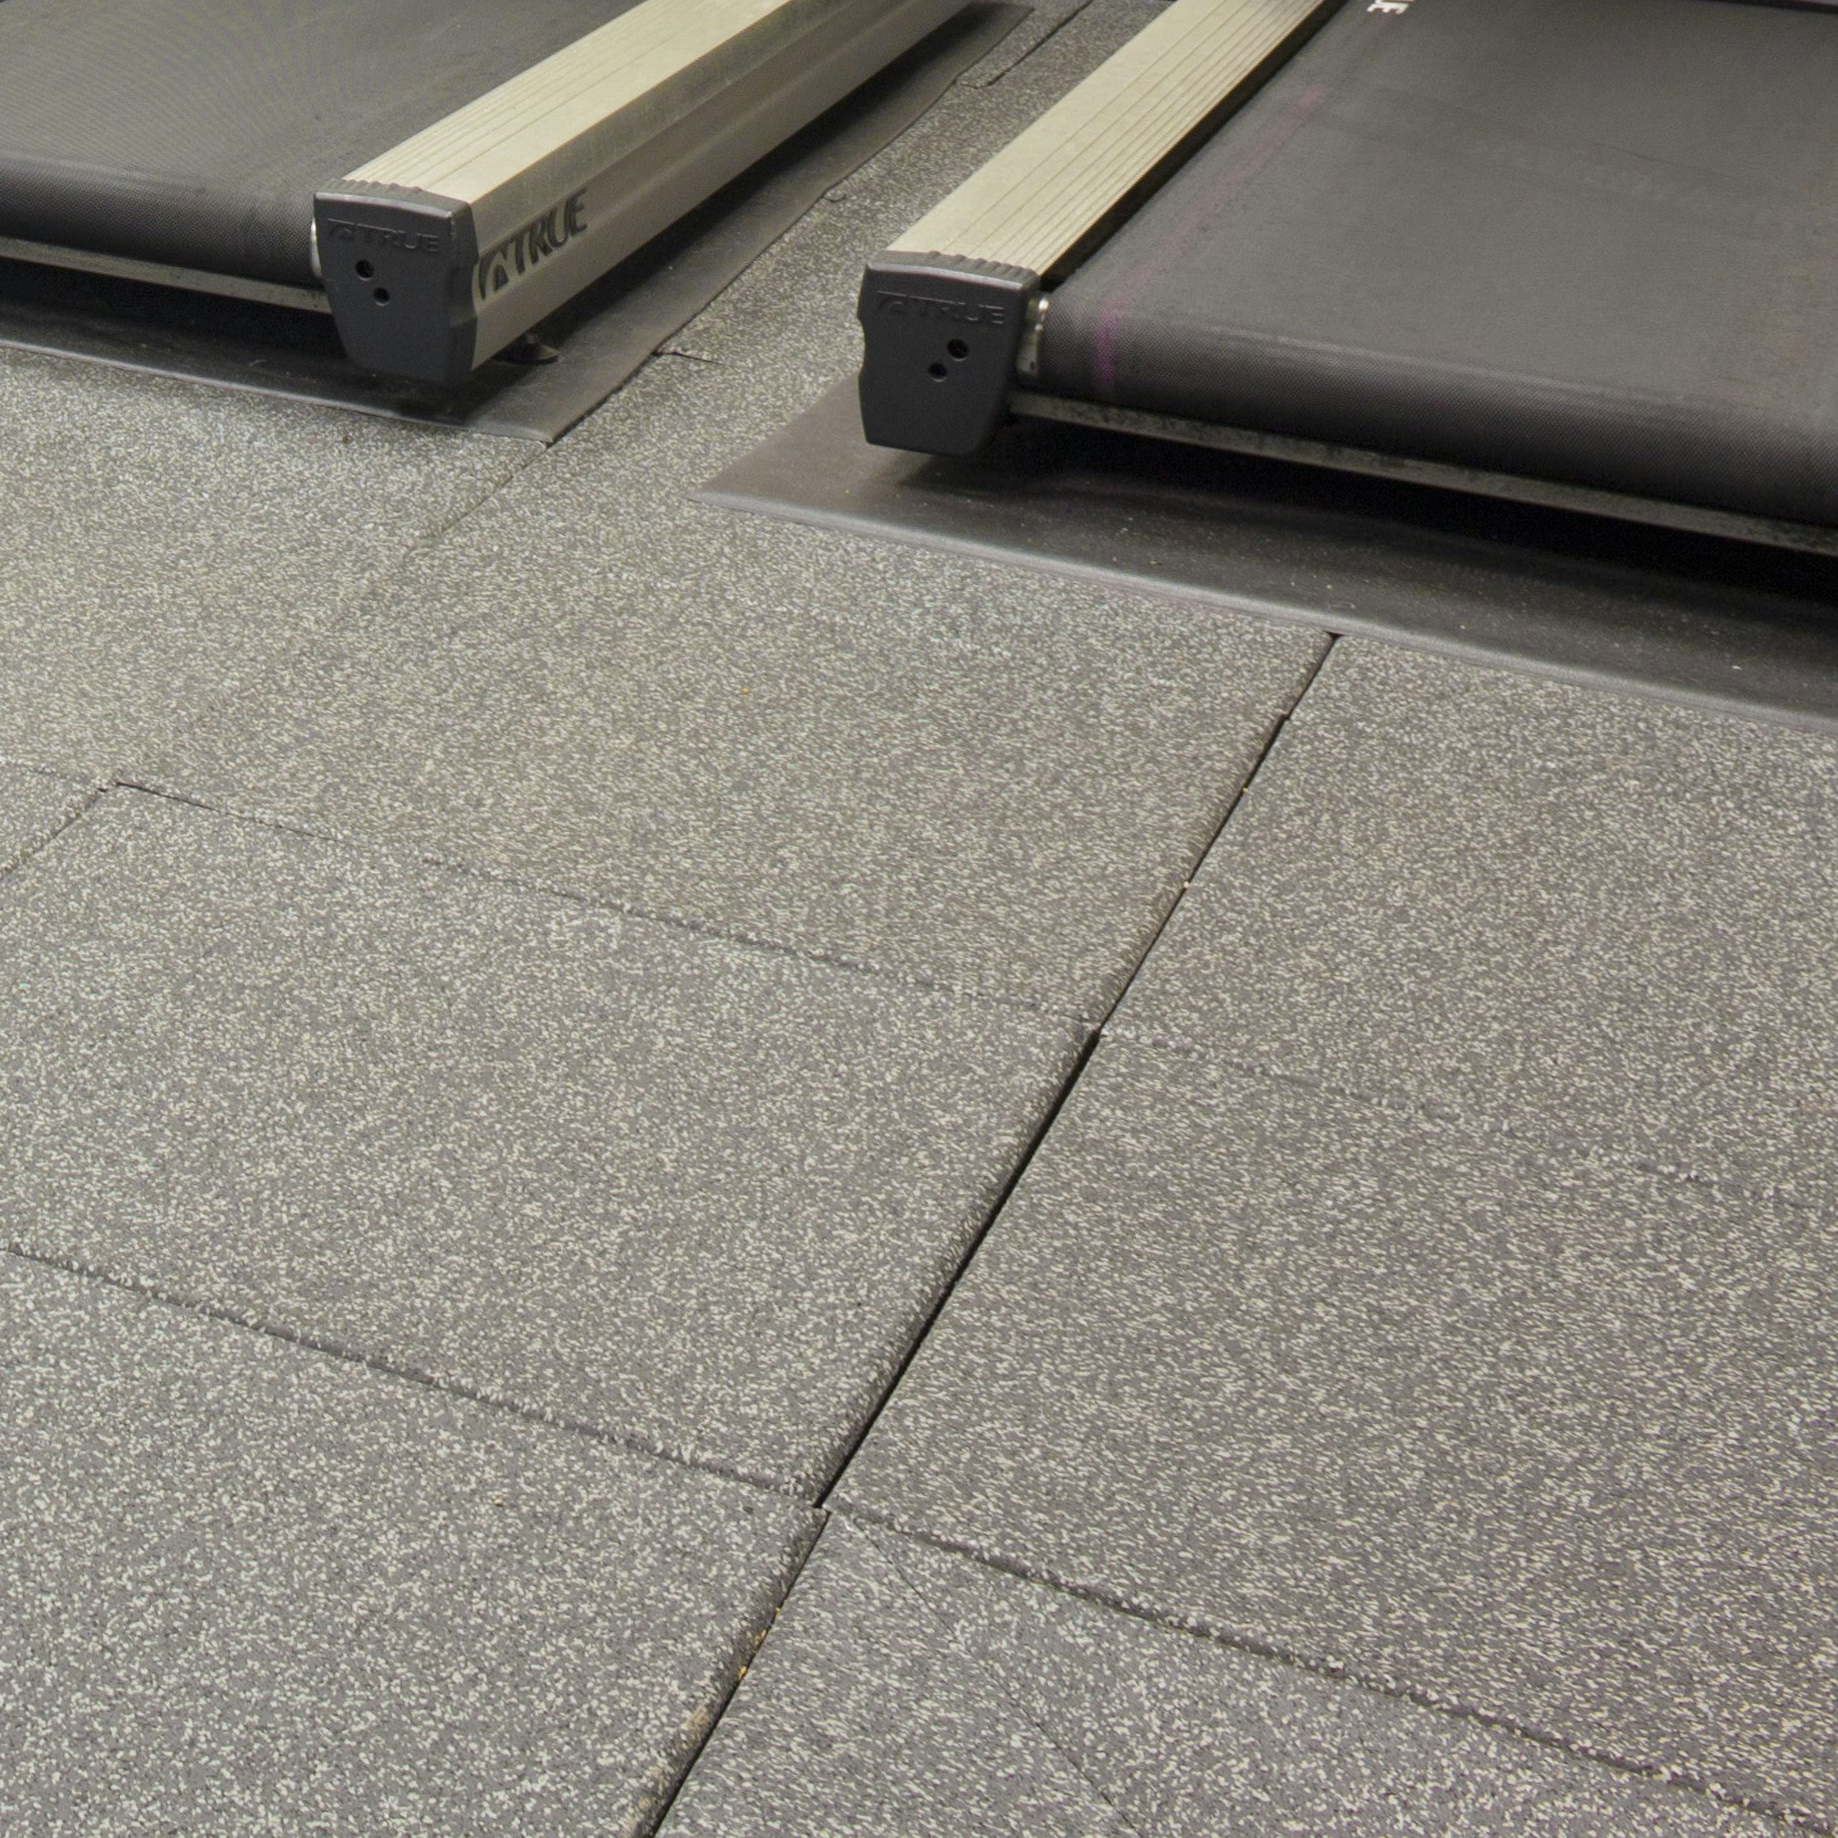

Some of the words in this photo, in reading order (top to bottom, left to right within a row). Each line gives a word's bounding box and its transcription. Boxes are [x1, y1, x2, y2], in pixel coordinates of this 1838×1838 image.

[356, 223, 439, 252] TRUE
[510, 188, 588, 277] TRUE
[909, 294, 1005, 325] TRUE
